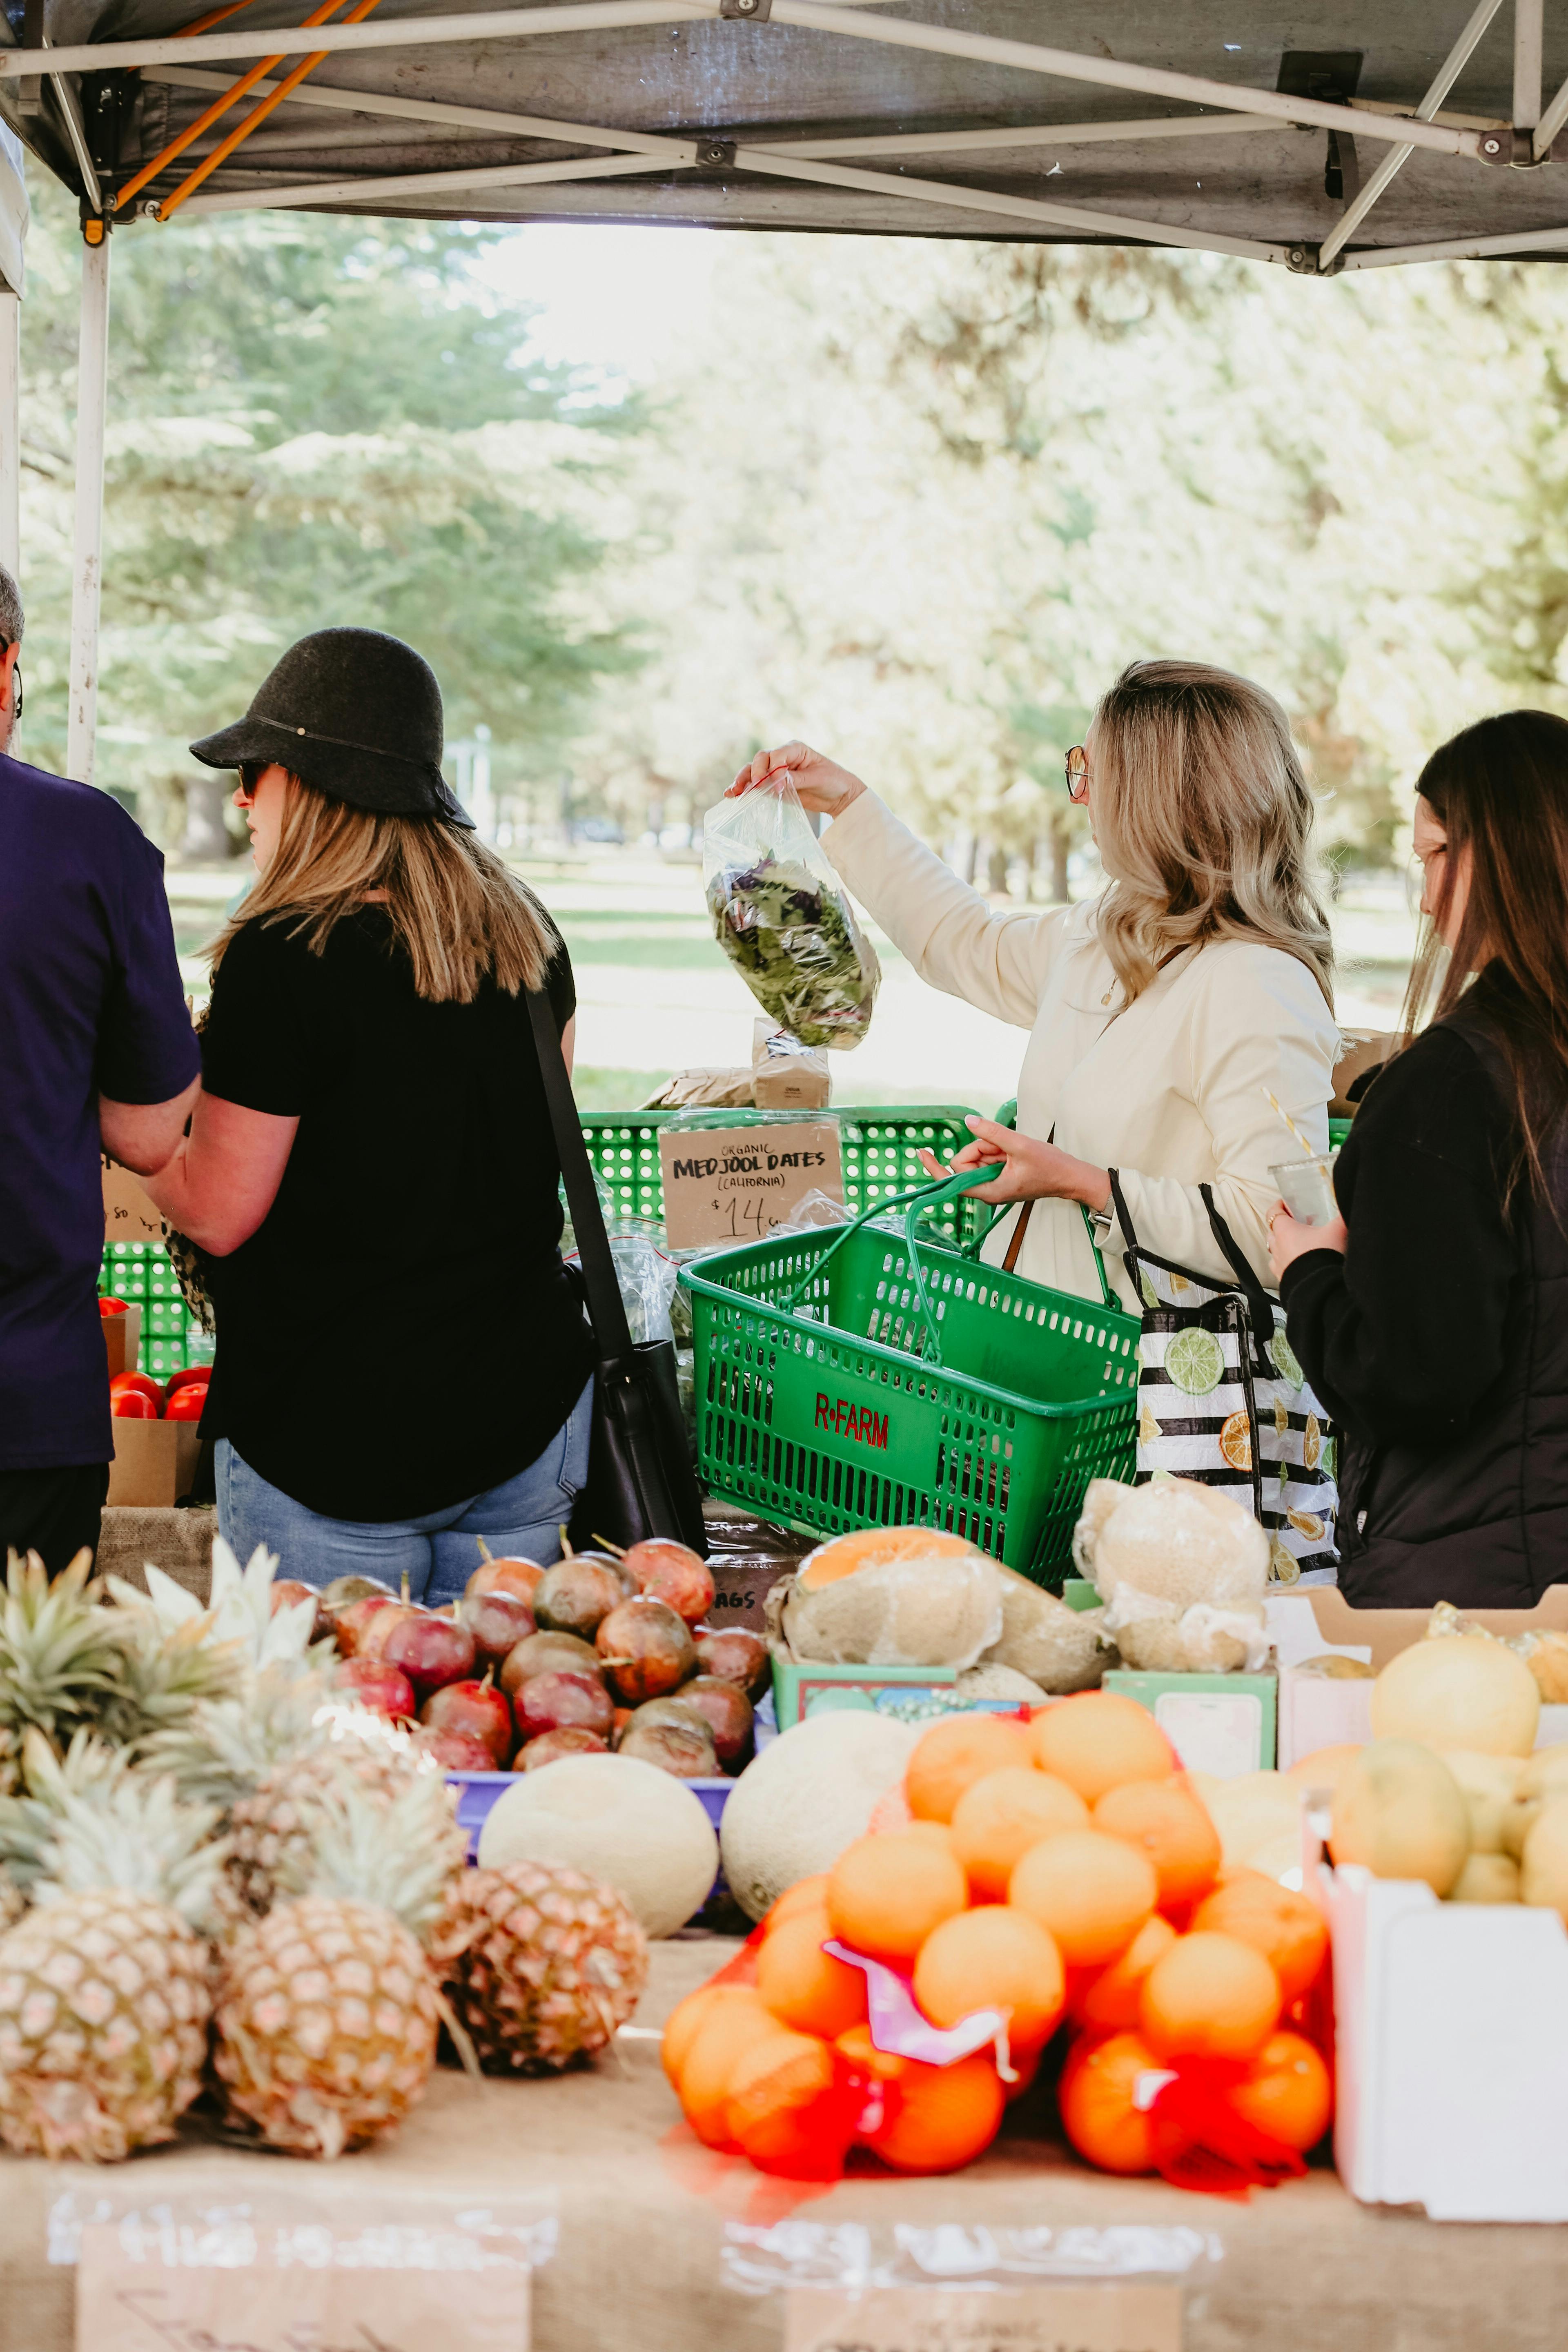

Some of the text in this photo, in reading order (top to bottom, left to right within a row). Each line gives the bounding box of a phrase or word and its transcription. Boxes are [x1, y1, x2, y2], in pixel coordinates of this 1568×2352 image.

[721, 1143, 775, 1156] ORGANIC
[674, 1152, 826, 1179] MEDJOOL DATES
[717, 1173, 785, 1191] (CALIFORNIA)
[715, 1591, 755, 1609] AGS
